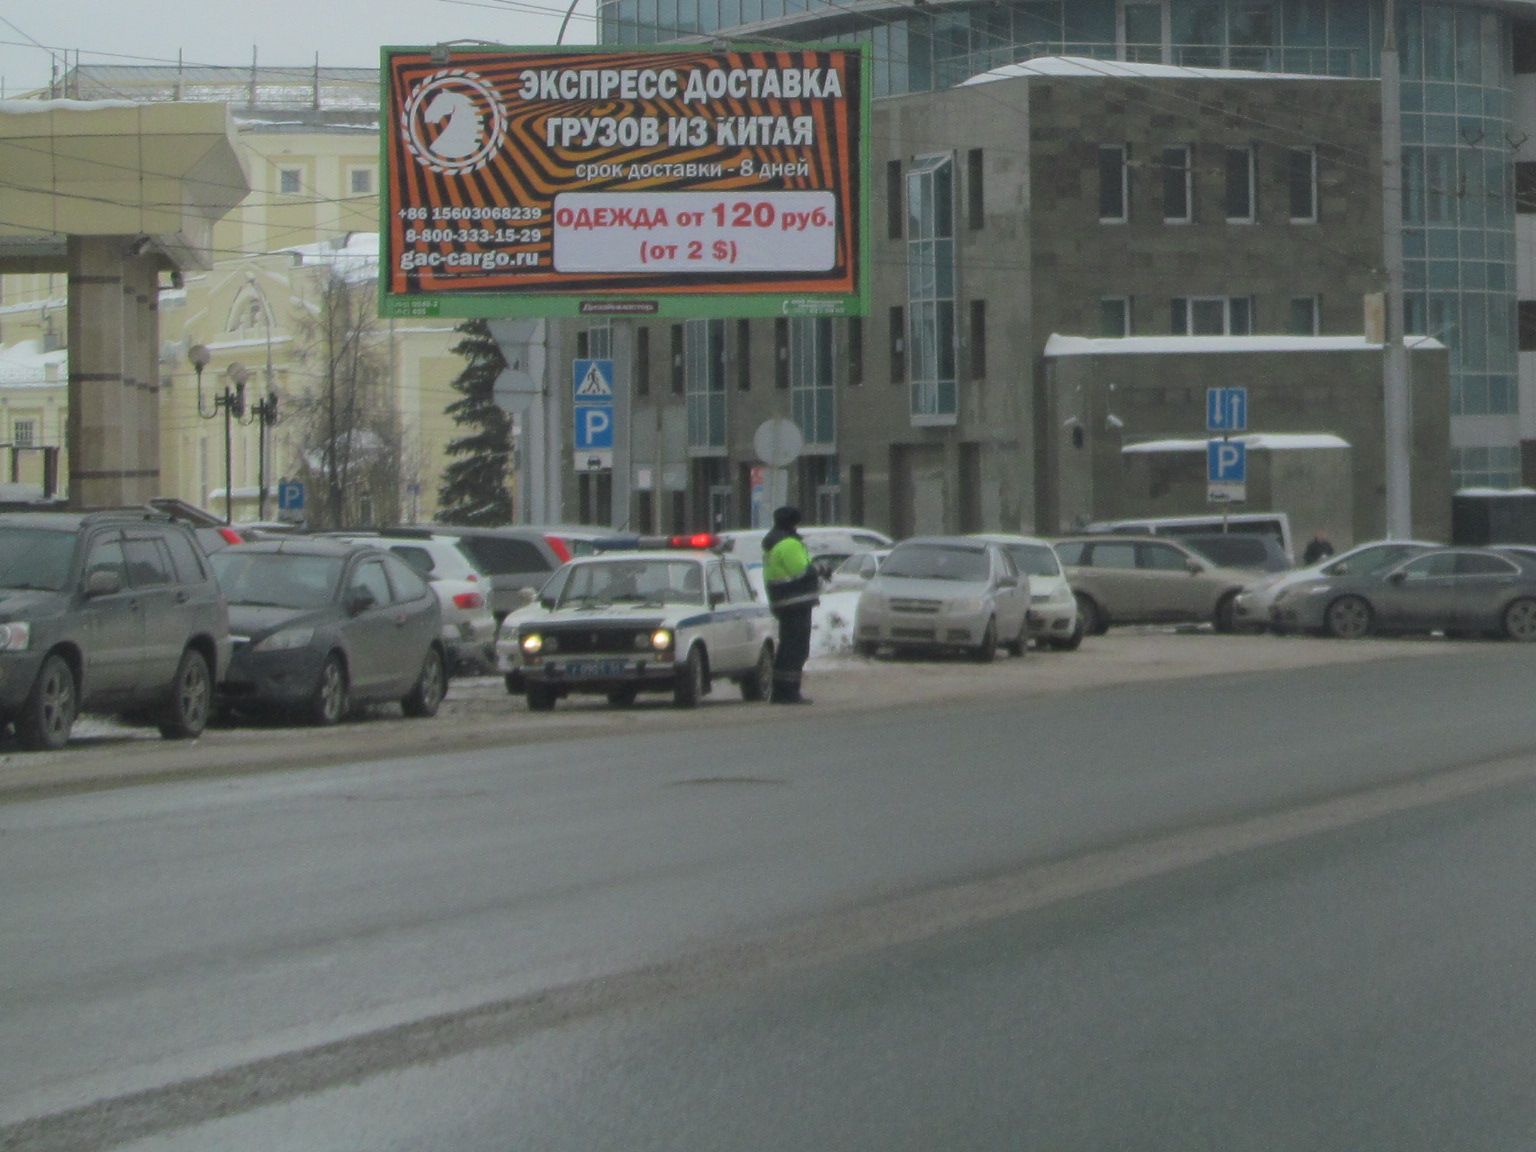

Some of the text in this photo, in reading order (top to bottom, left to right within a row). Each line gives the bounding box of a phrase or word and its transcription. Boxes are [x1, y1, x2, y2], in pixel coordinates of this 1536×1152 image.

[518, 67, 843, 105] ЭКСПРЕСС ДОСТАВКА
[546, 114, 813, 147] ГРУЗОВ ИЗ КИТАЯ
[575, 162, 623, 181] срок
[627, 161, 722, 180] доставки
[739, 159, 754, 177] 8
[758, 157, 809, 179] дней
[398, 206, 542, 220] +86 15603068239
[555, 201, 834, 231] ОДЕЖДА от 120 руб.
[405, 228, 542, 243] 8-800-333-15-29
[400, 249, 539, 270] gac-cargo.ru
[640, 239, 737, 264] (от 2 $)
[586, 410, 609, 444] P
[1218, 445, 1239, 478] P
[285, 486, 300, 506] P
